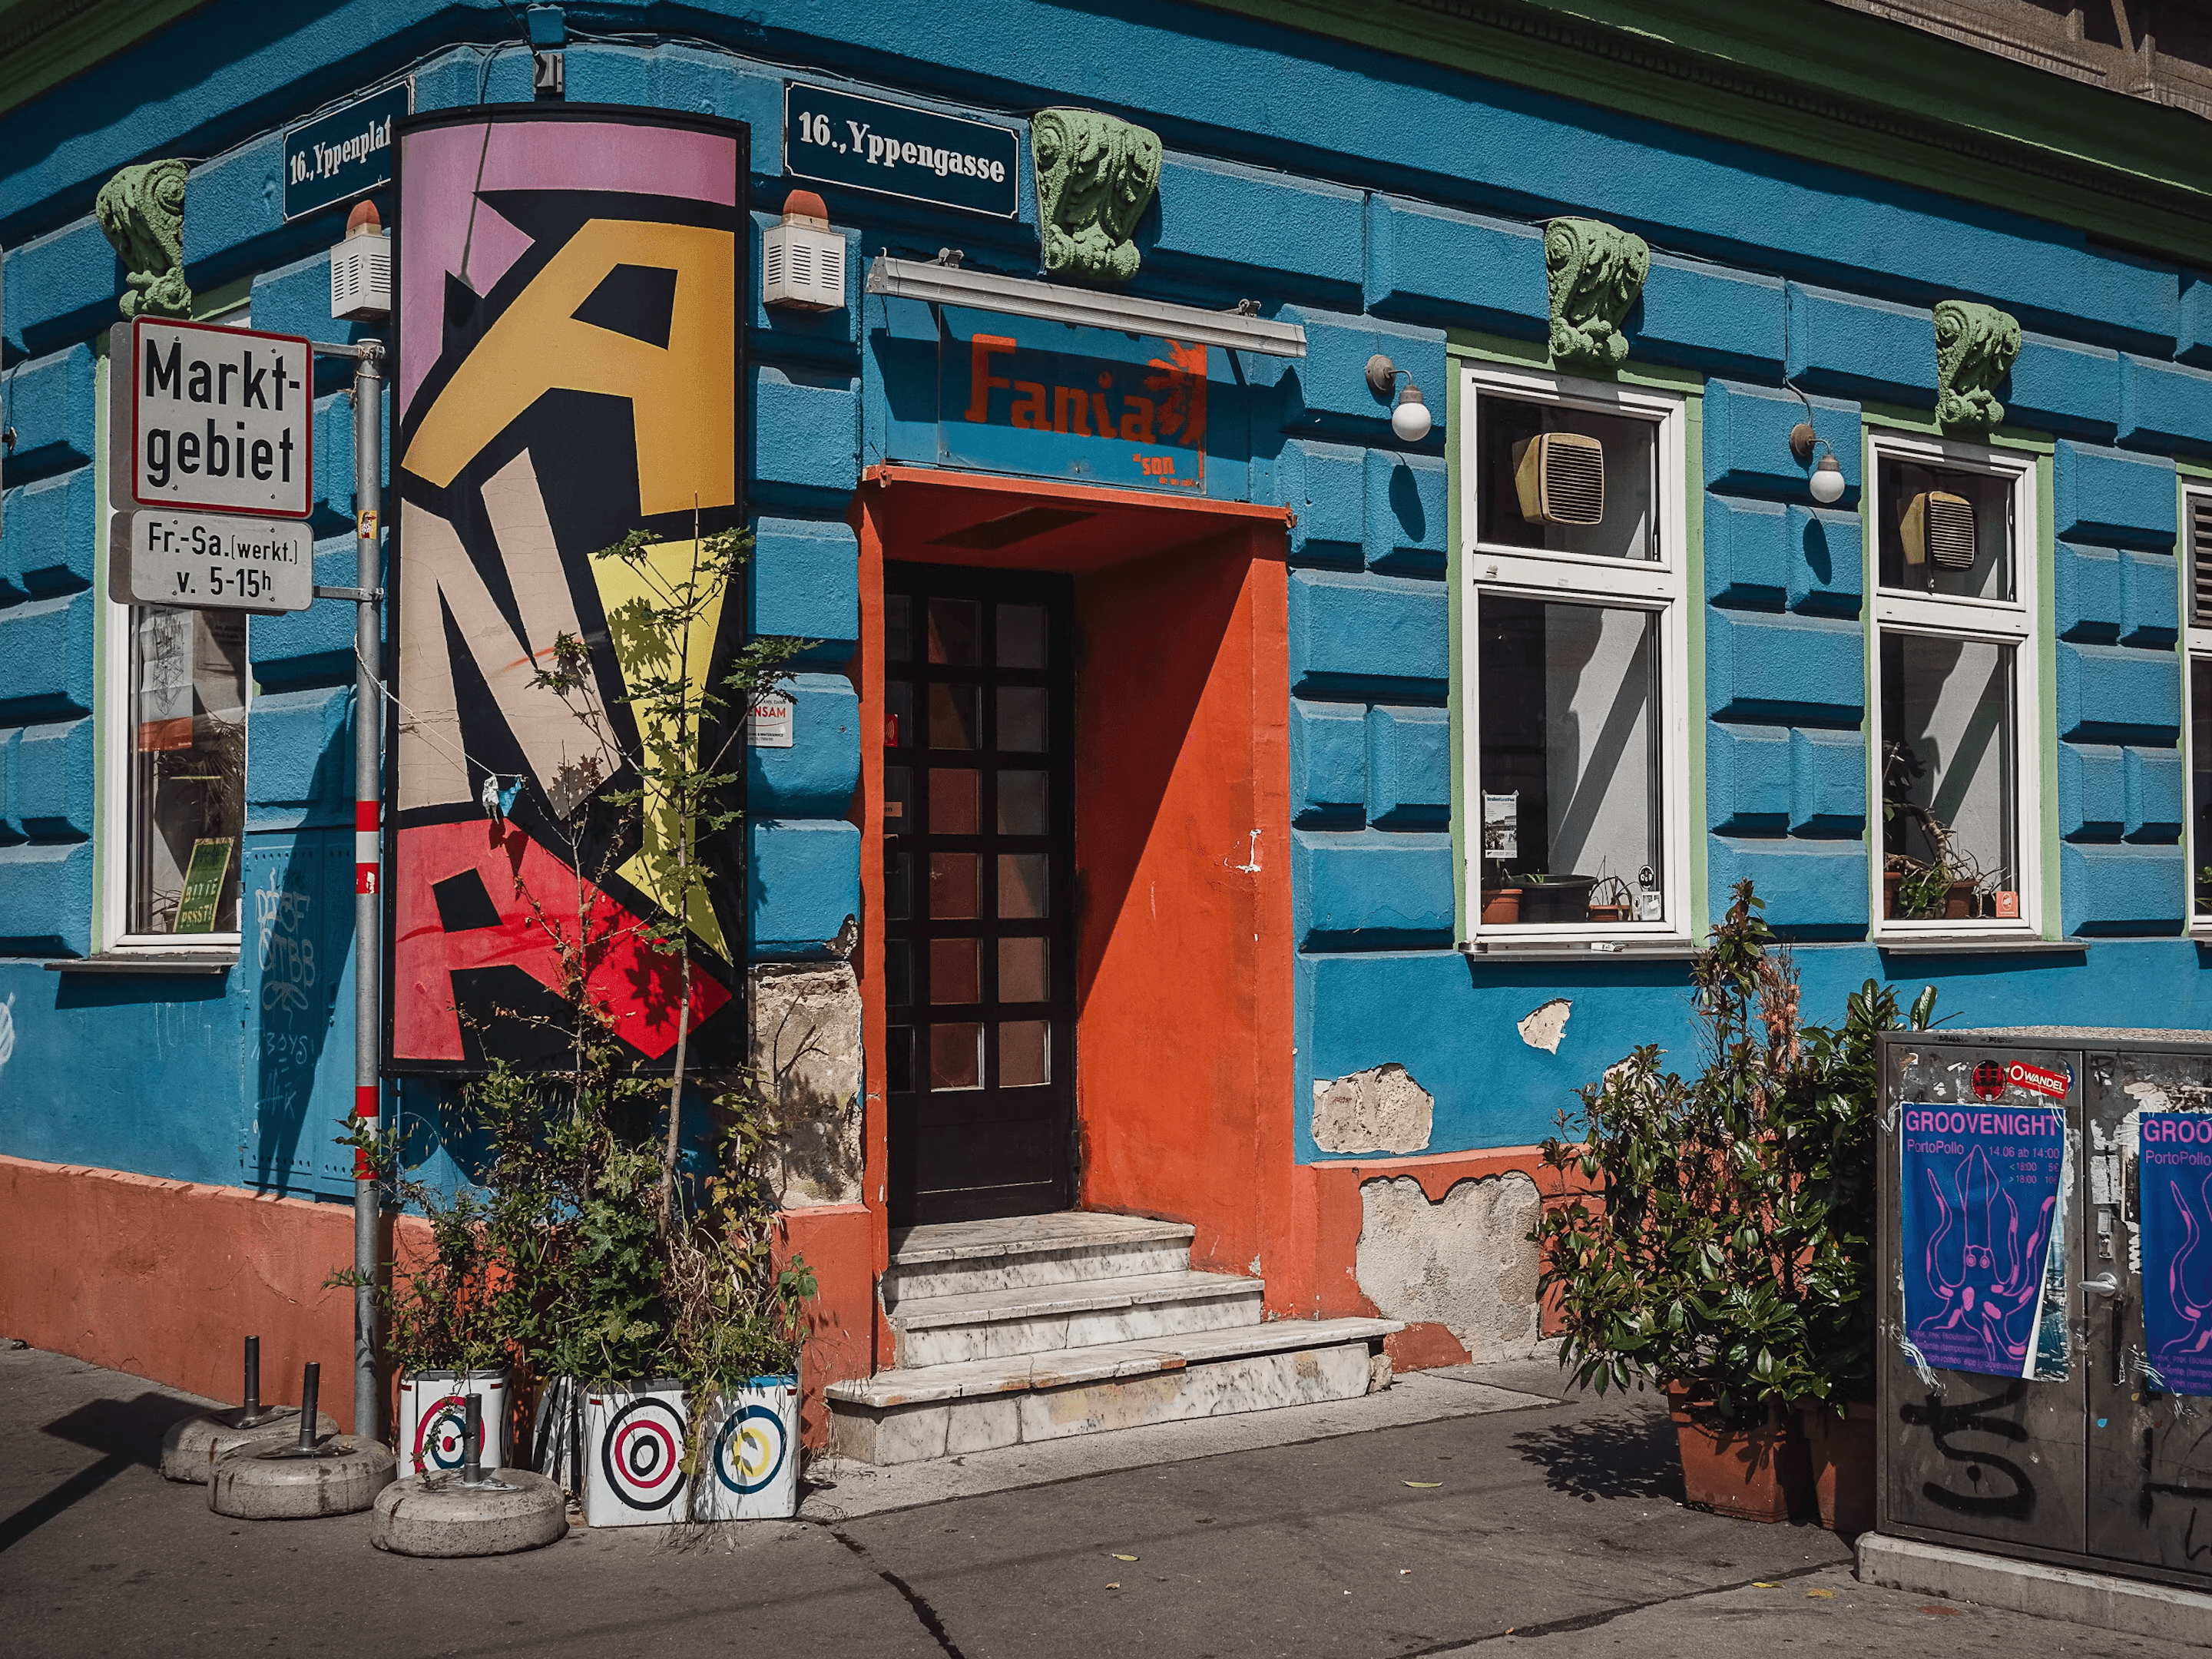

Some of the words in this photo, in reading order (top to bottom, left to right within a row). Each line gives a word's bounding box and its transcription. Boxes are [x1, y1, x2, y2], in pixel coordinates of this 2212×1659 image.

[846, 120, 1005, 183] Yppengasse
[145, 338, 301, 412] Markt-
[963, 333, 1157, 445] Fania
[147, 418, 294, 488] gebiet
[177, 571, 197, 594] v.
[210, 566, 272, 598] 5-15h
[1906, 1111, 2058, 1136] GROOVENIGHT
[1906, 1138, 1965, 1154] PortoPollo
[2018, 1148, 2029, 1158] ab
[2145, 1149, 2212, 1167] PortoPollo
